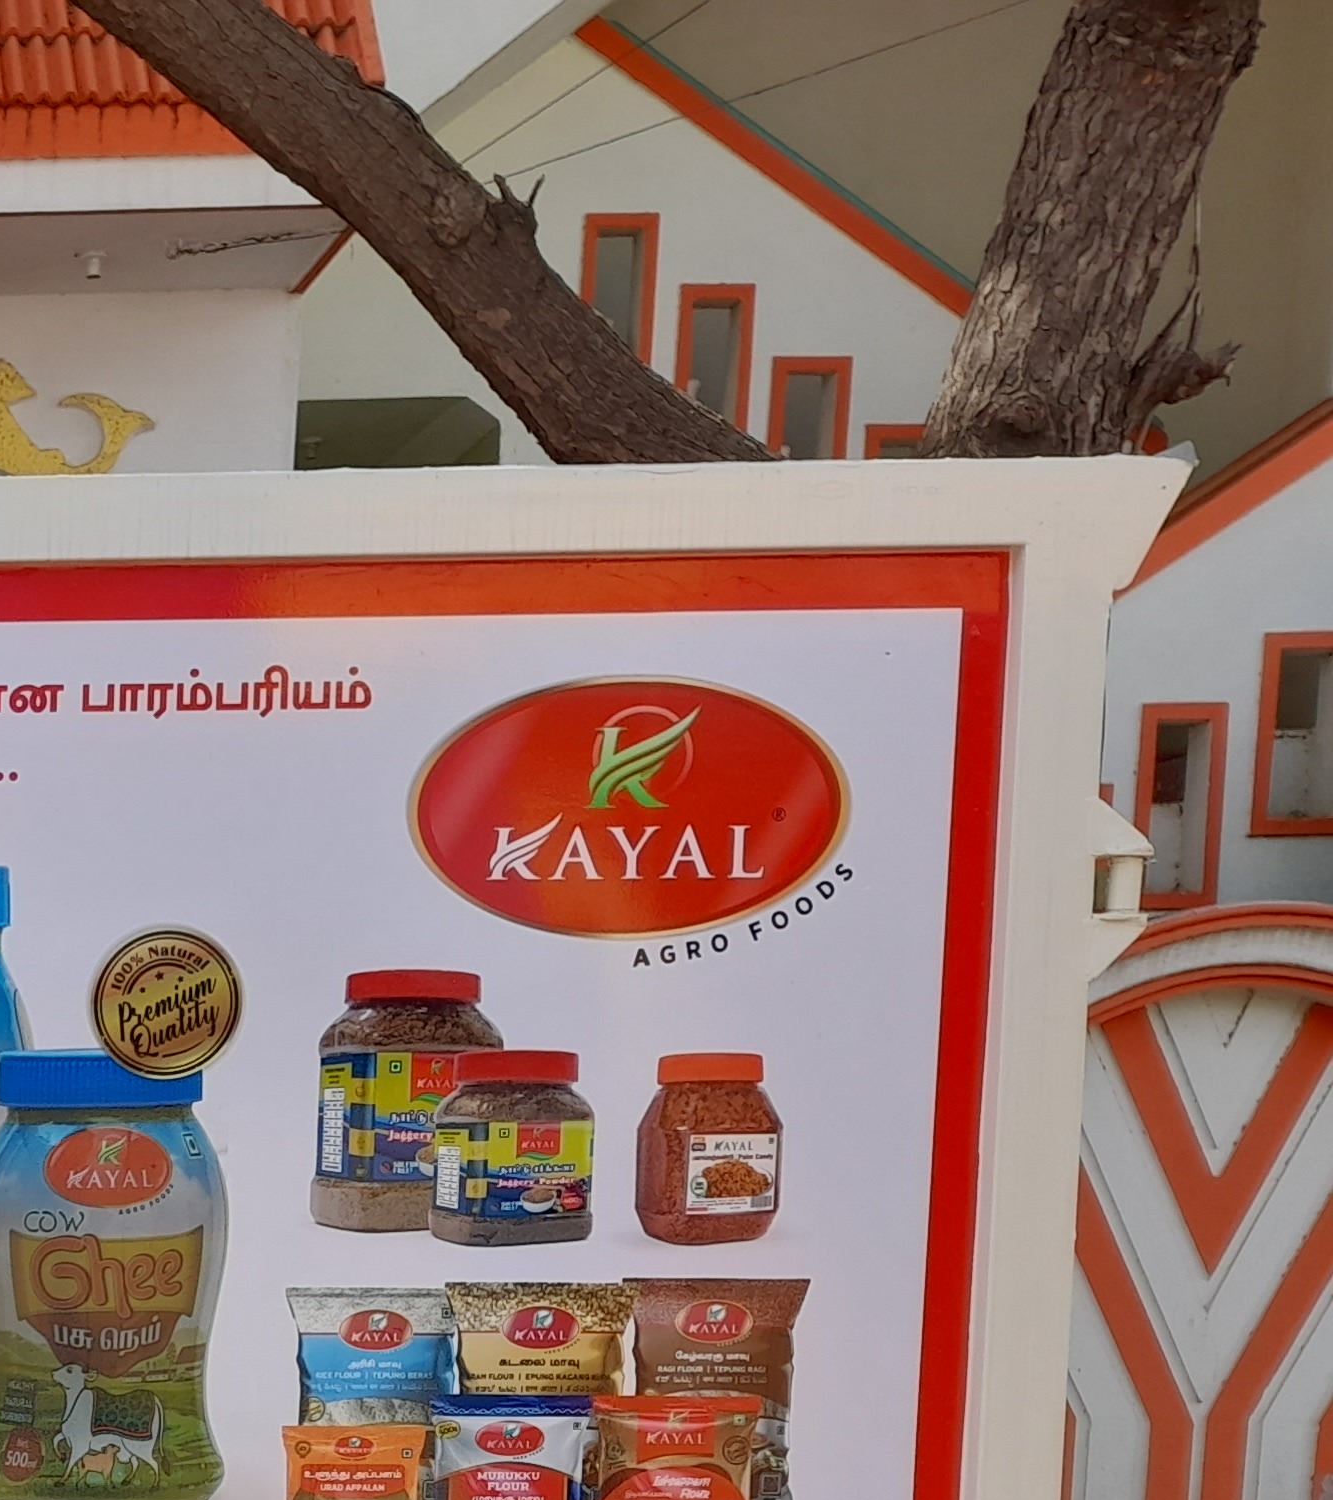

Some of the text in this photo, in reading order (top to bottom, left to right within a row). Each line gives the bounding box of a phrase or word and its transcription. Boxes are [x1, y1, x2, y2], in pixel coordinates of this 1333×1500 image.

[81, 665, 372, 719] பாரம்பரியம்
[486, 812, 765, 881] KAYAL
[633, 862, 854, 968] AGRO FOODS
[111, 944, 211, 991] 100% Natural
[118, 977, 217, 1042] Premium
[130, 1000, 220, 1058] Quality
[714, 1140, 754, 1151] KAYAL
[67, 1169, 154, 1189] KAYAL
[24, 1210, 85, 1233] COW
[30, 1233, 183, 1318] Ghee
[53, 1315, 161, 1354] பசு நெய்
[514, 1329, 566, 1341] KAYAL
[688, 1322, 739, 1334] KAYAL
[351, 1330, 400, 1343] KAYAL
[334, 1371, 361, 1380] FLOUR
[677, 1365, 704, 1373] FLOUR
[486, 1440, 533, 1449] KAYAL
[645, 1431, 707, 1445] KAYAL
[477, 1471, 541, 1481] MURUKKU
[320, 1483, 344, 1491] URAD
[487, 1481, 530, 1491] FLOUR
